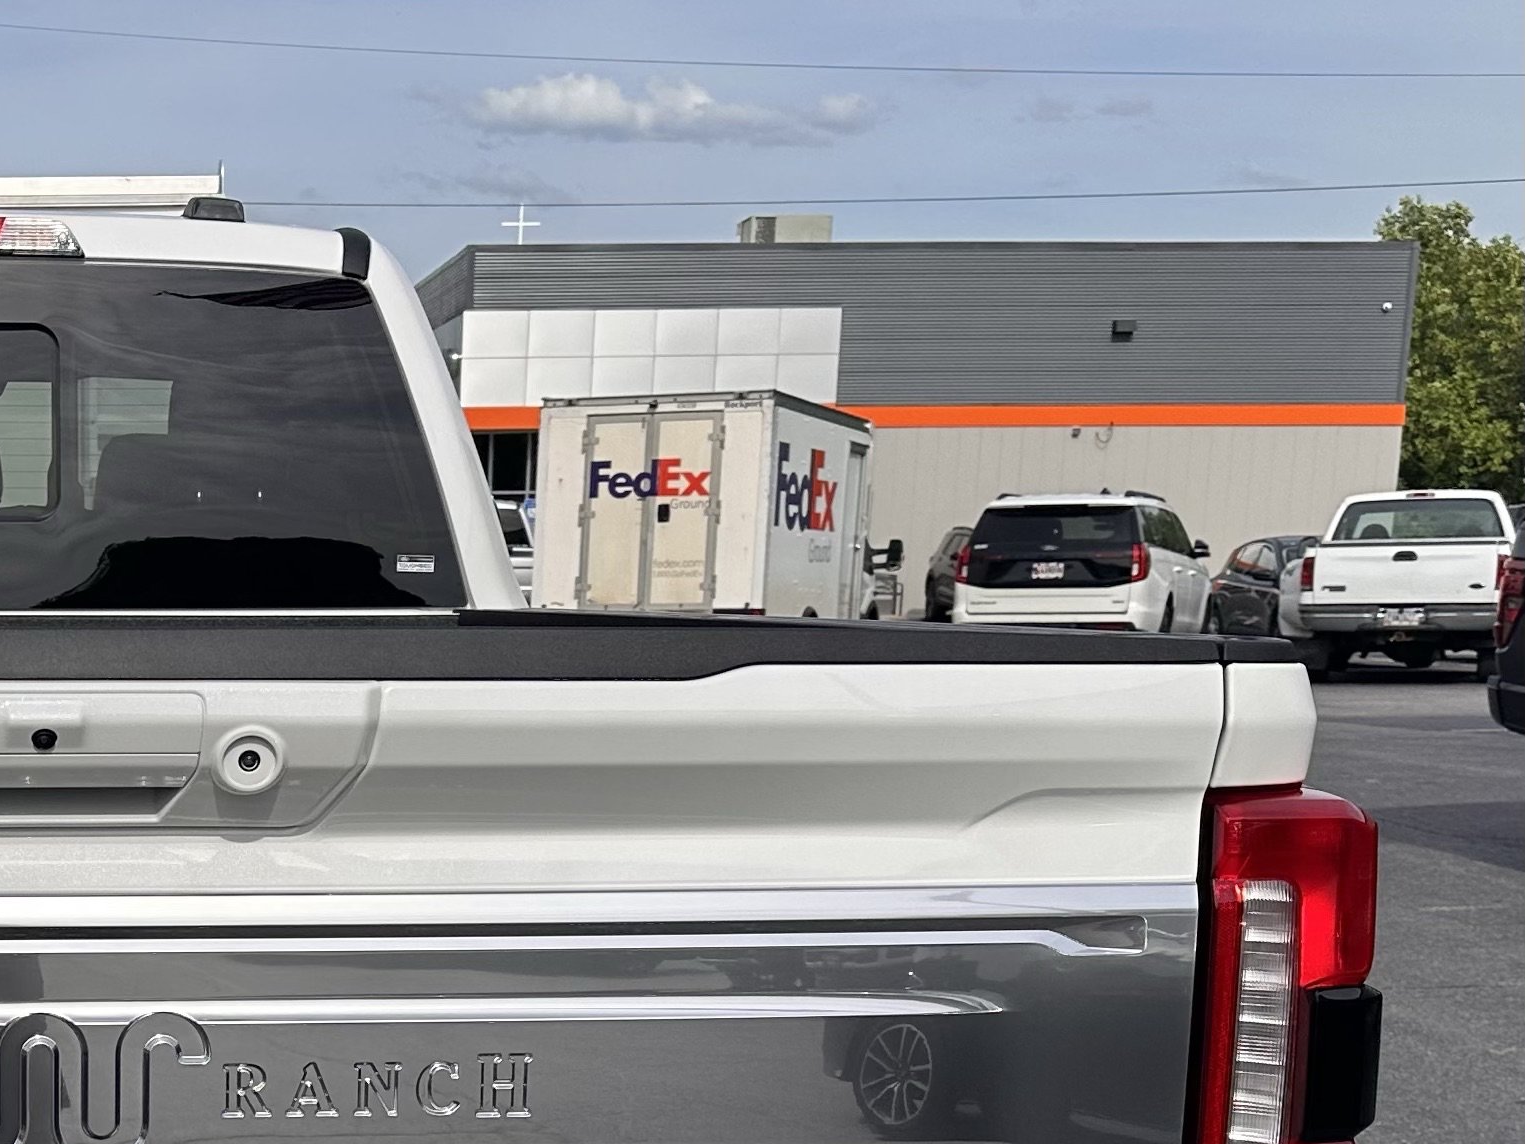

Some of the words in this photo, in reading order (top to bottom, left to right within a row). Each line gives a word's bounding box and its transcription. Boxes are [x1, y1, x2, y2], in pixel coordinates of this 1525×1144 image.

[589, 458, 711, 499] FedEx
[774, 441, 838, 532] FedEx
[219, 1053, 533, 1118] RANCH
